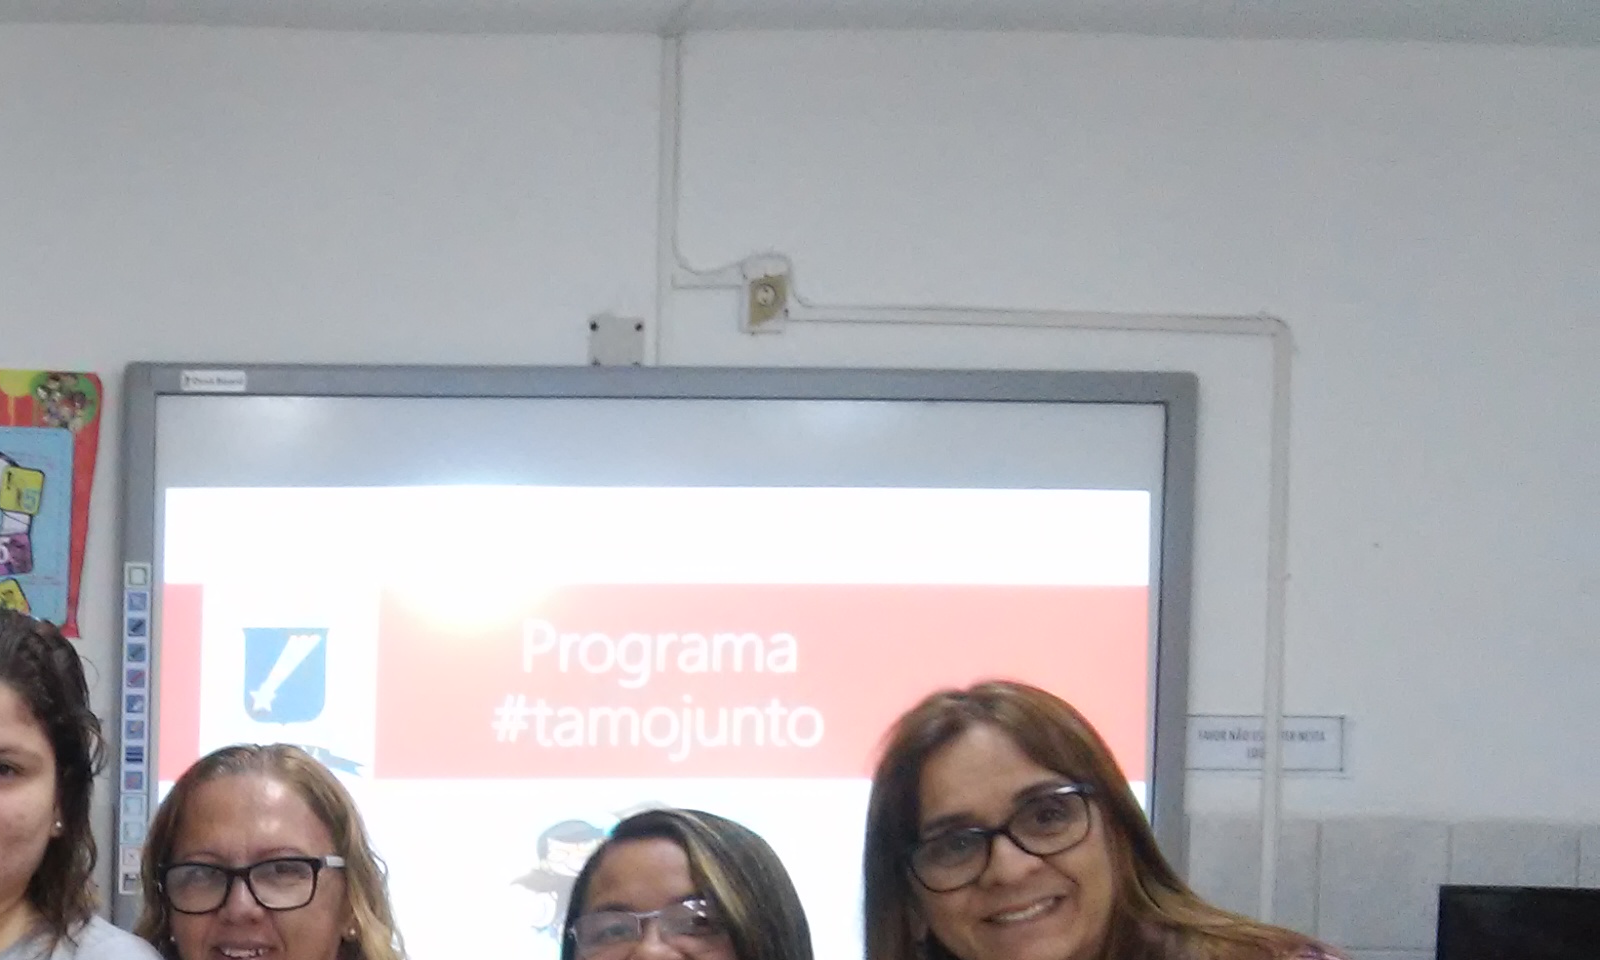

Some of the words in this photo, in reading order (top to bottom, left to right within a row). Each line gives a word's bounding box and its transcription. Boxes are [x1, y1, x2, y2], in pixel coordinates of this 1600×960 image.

[22, 488, 40, 513] 5
[521, 618, 799, 689] Programa
[490, 693, 826, 763] #tamojunto
